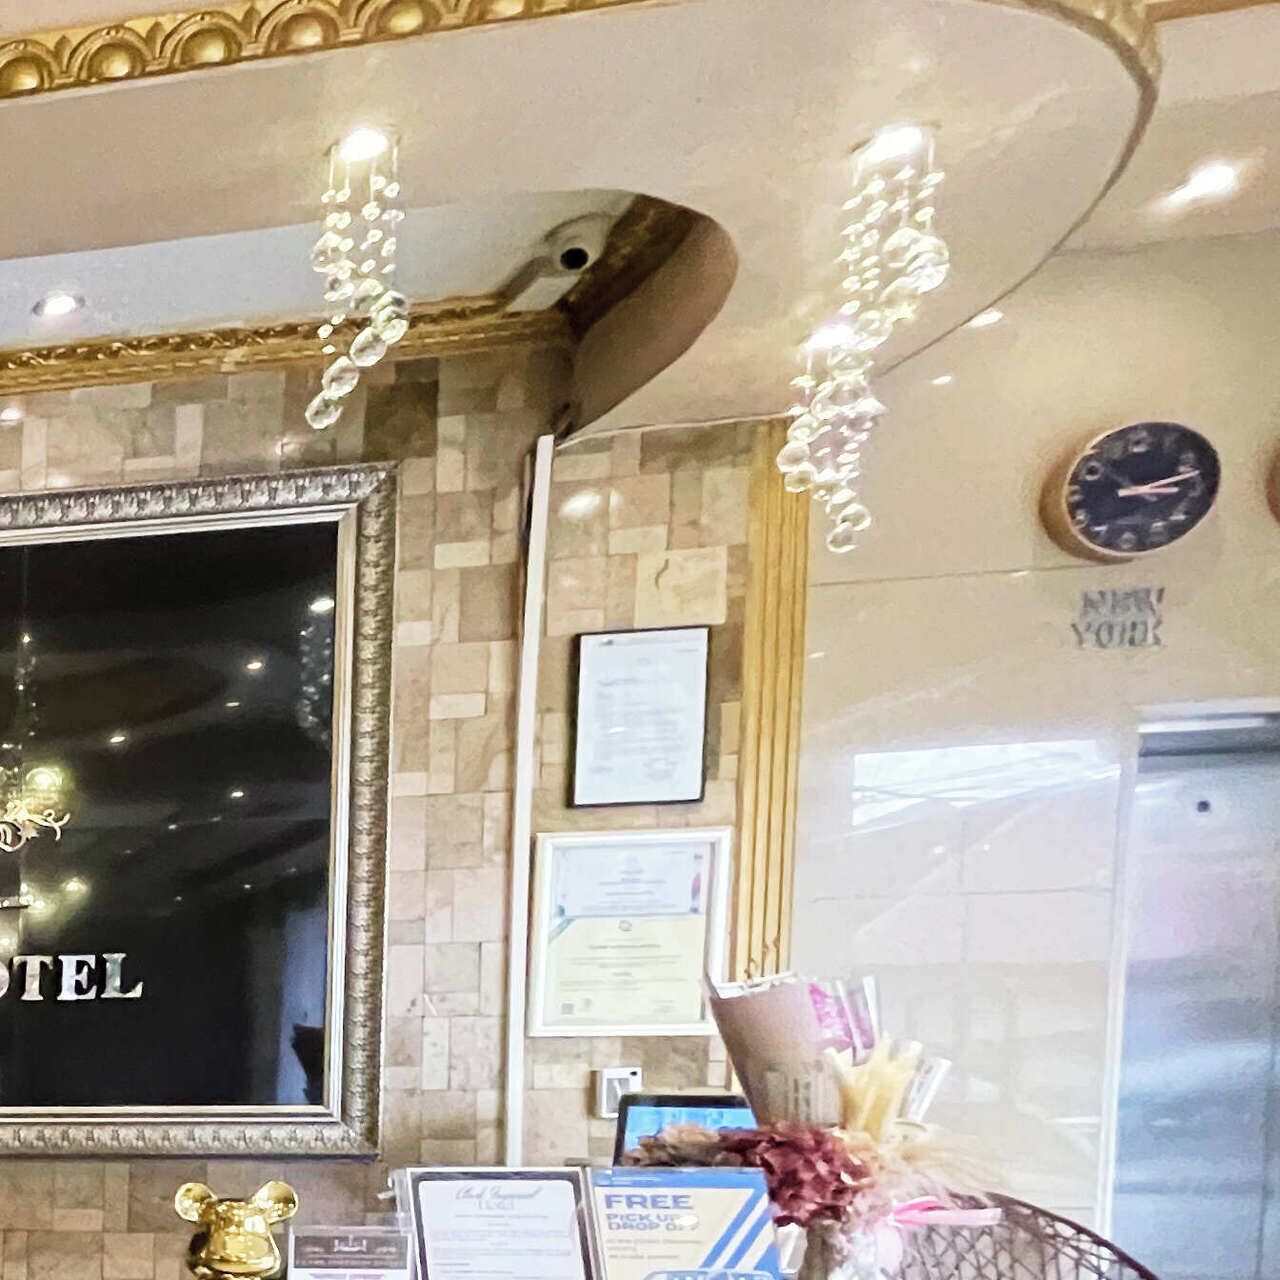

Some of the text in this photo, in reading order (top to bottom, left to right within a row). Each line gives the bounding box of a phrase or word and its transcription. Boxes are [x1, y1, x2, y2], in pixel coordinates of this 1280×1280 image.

[605, 1195, 693, 1209] FREE
[606, 1213, 651, 1222] PICK
[608, 1222, 660, 1231] DROP
